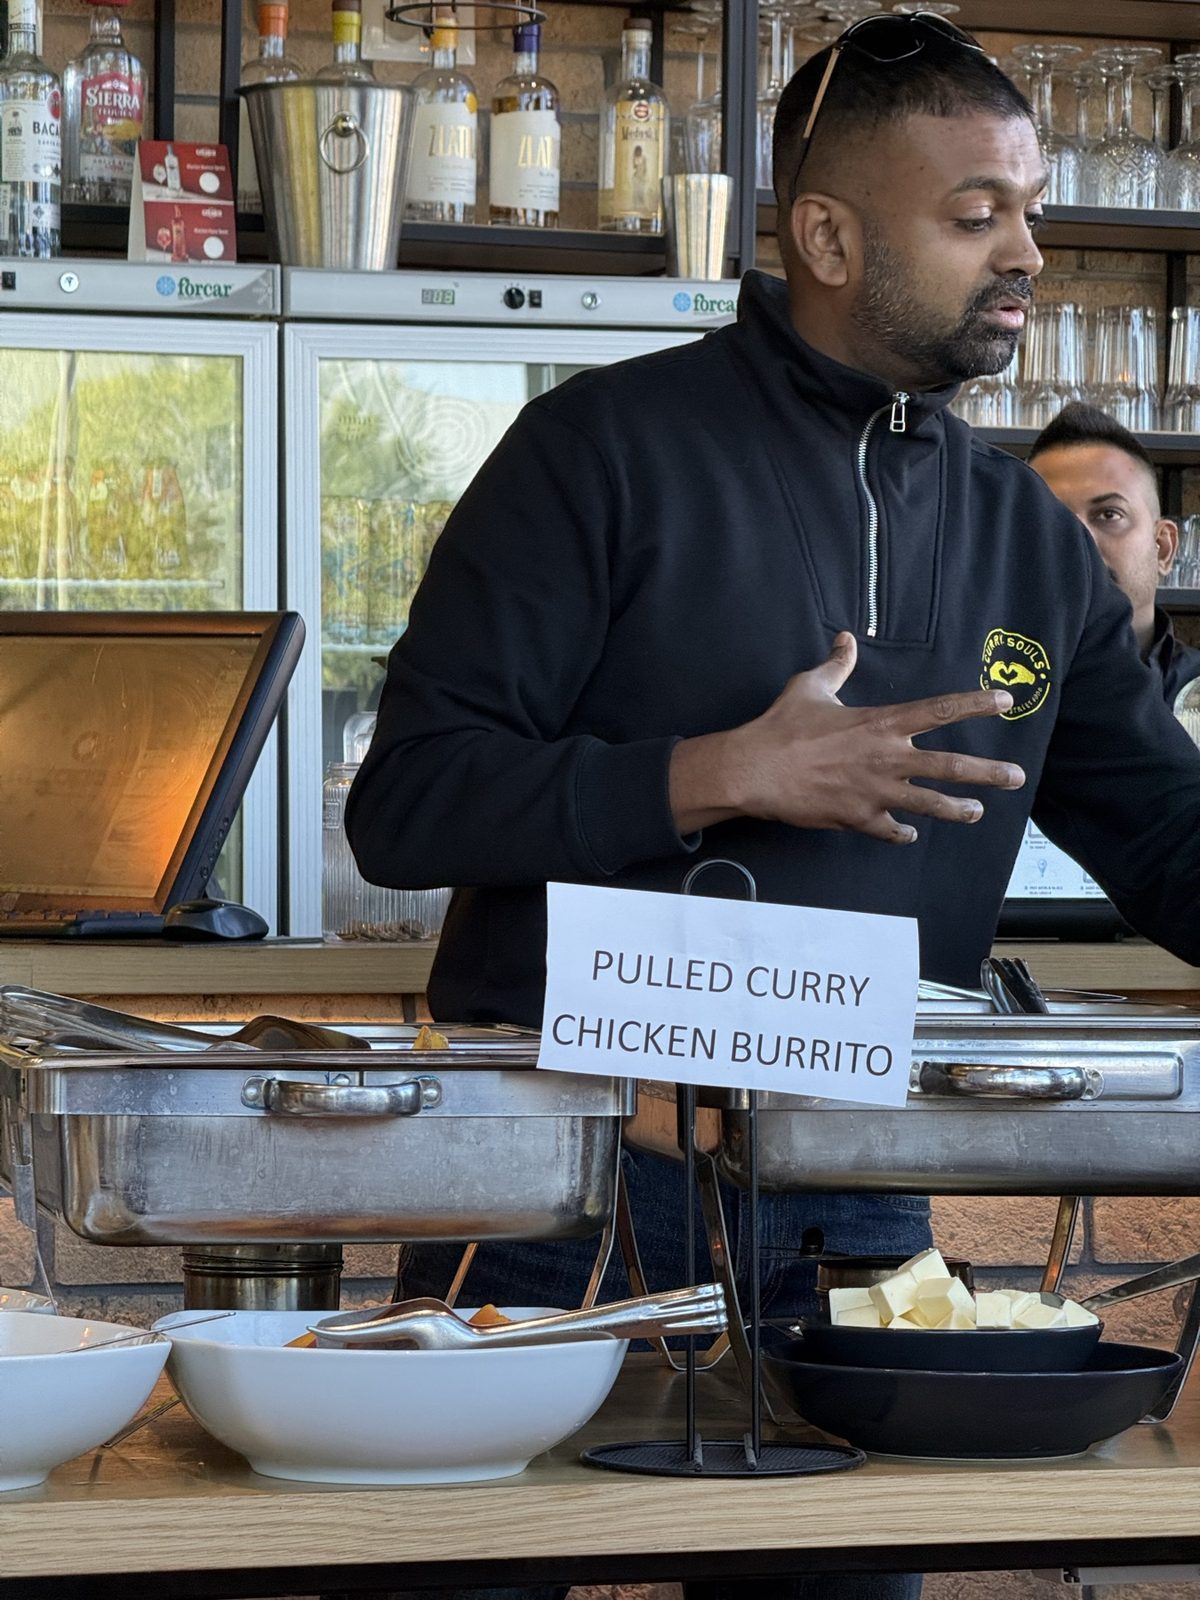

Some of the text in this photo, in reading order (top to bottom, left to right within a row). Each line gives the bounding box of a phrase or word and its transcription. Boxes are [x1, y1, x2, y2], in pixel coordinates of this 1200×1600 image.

[86, 85, 140, 110] SIERRA
[178, 277, 232, 298] forcar
[693, 293, 735, 312] forca
[1007, 637, 1045, 670] SOULS
[592, 950, 870, 1007] PULLED CURRY
[552, 1014, 893, 1077] CHICKEN BURRITO
